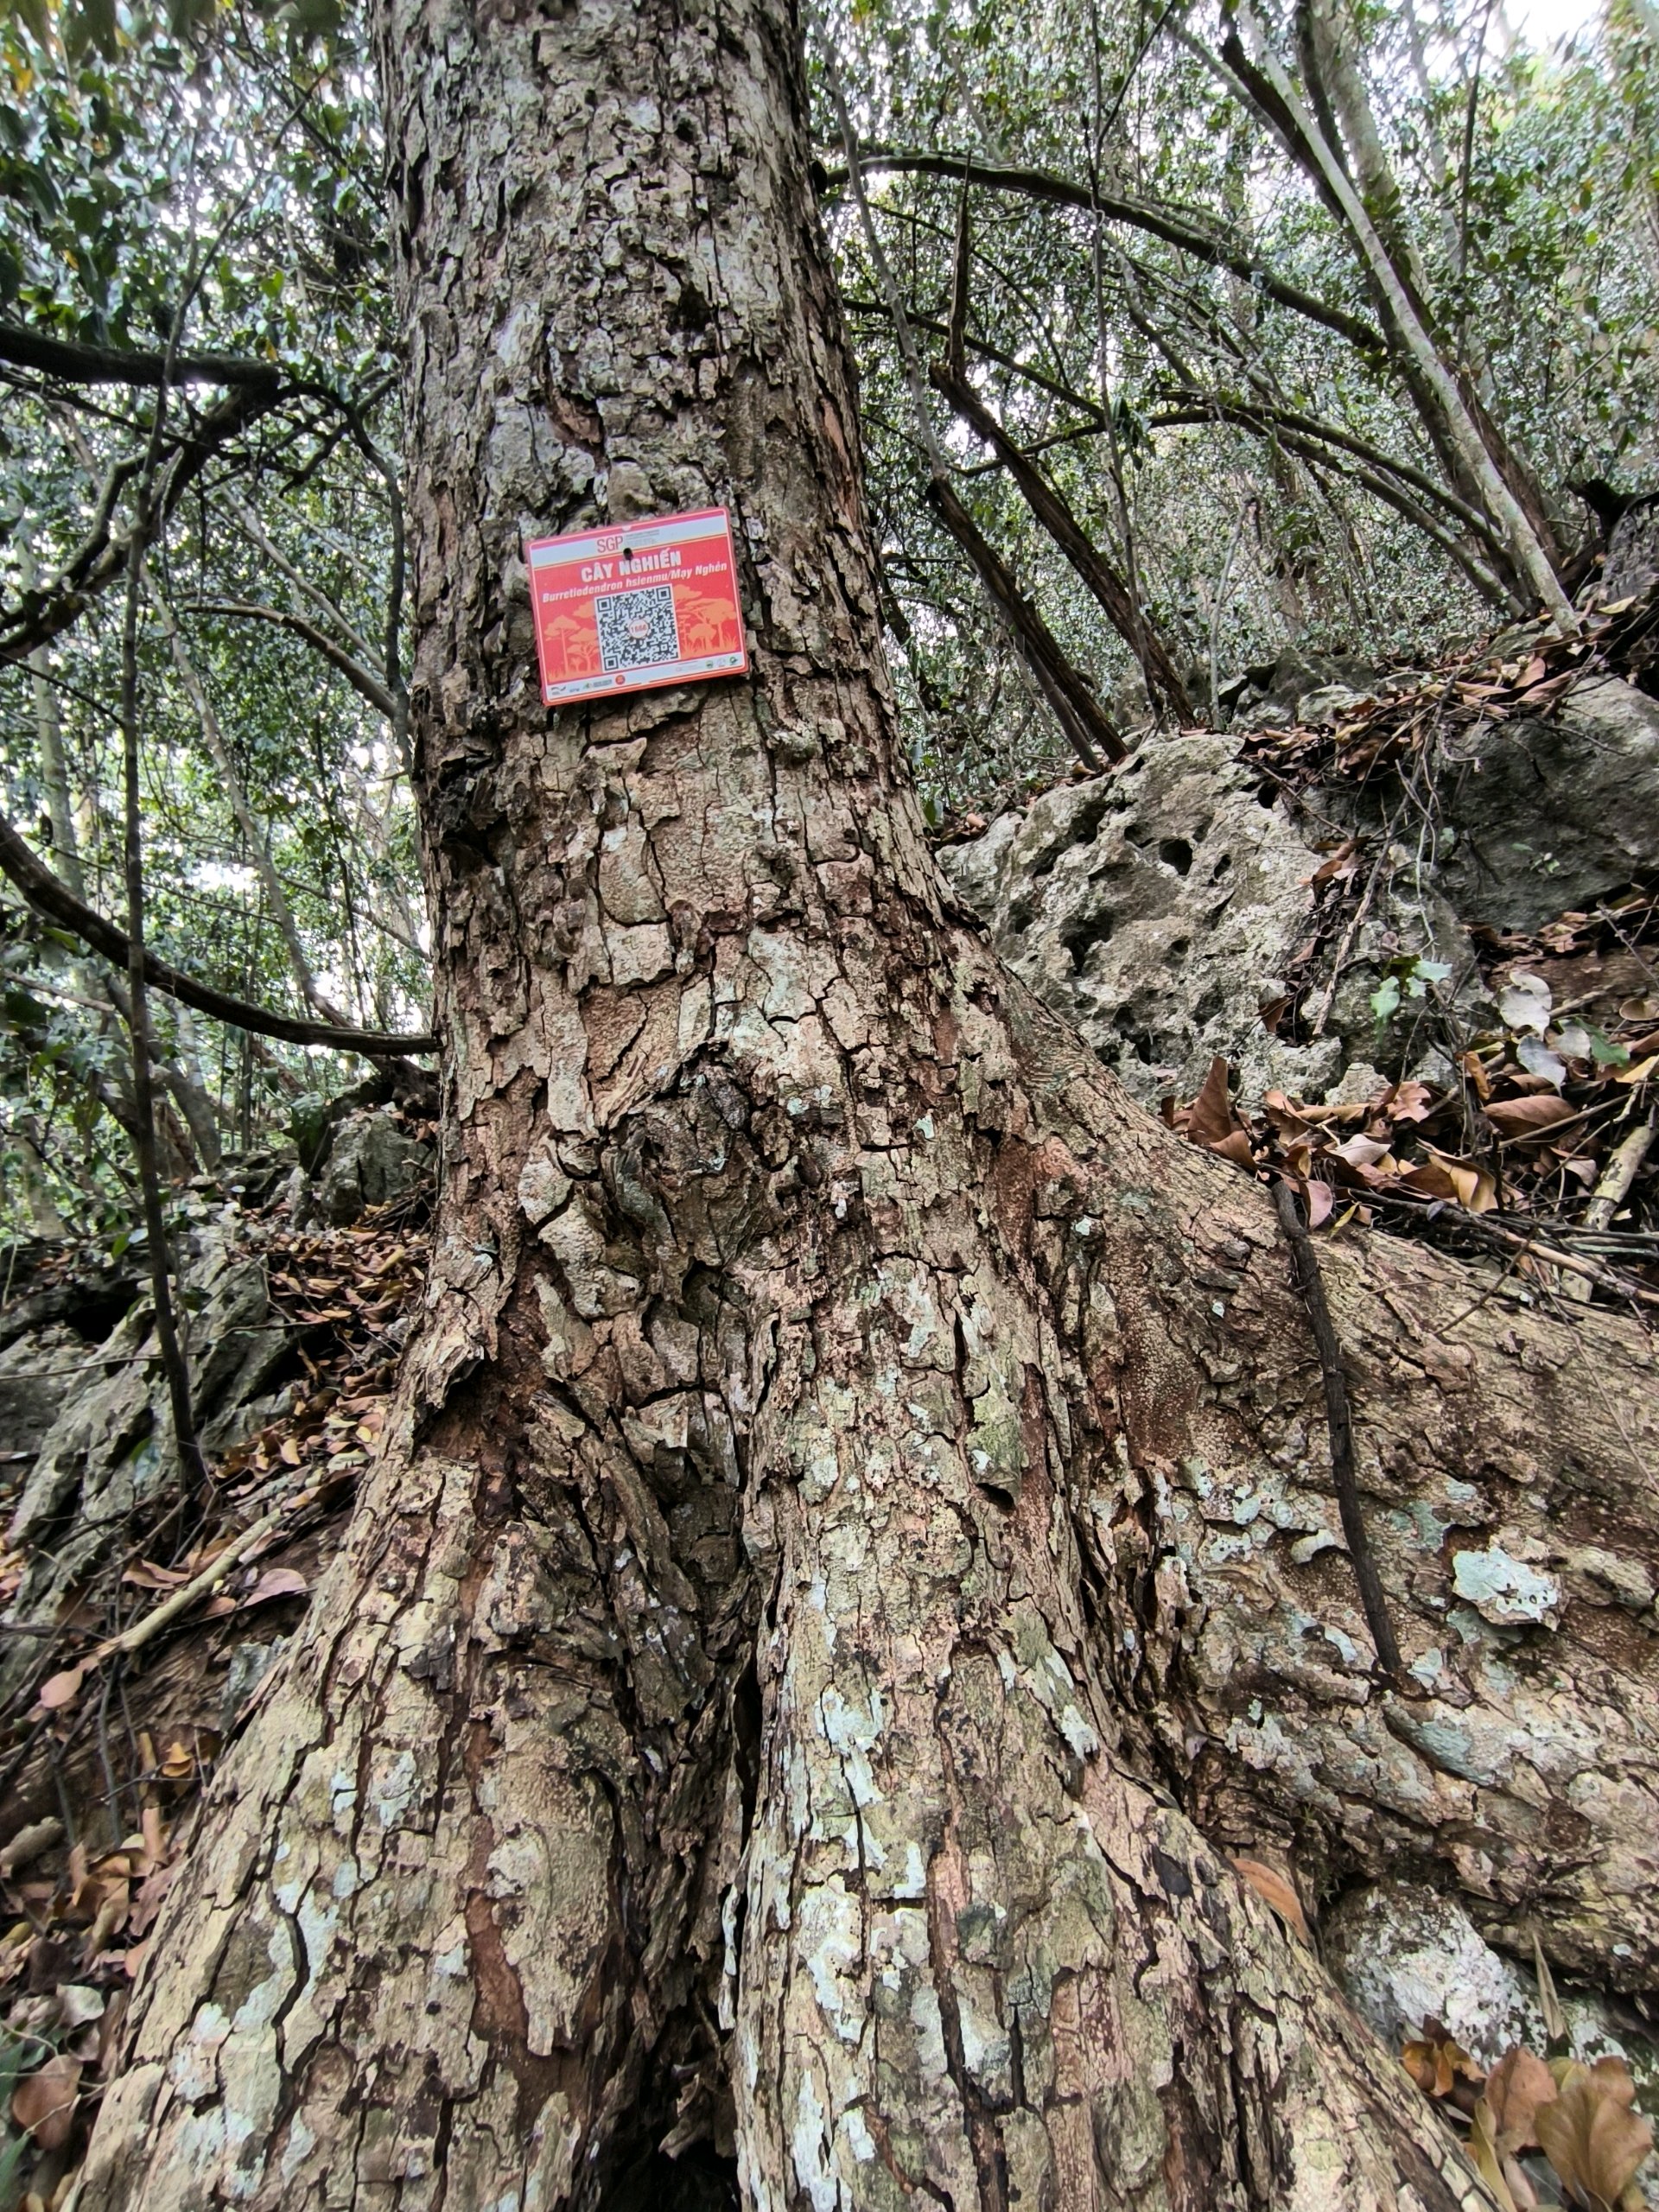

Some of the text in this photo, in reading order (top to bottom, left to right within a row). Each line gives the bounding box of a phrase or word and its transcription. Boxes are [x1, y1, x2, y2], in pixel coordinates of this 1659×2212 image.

[596, 535, 624, 553] SGP
[581, 548, 682, 582] CÂY NGHIẾN
[543, 581, 623, 603] Burretiodendron
